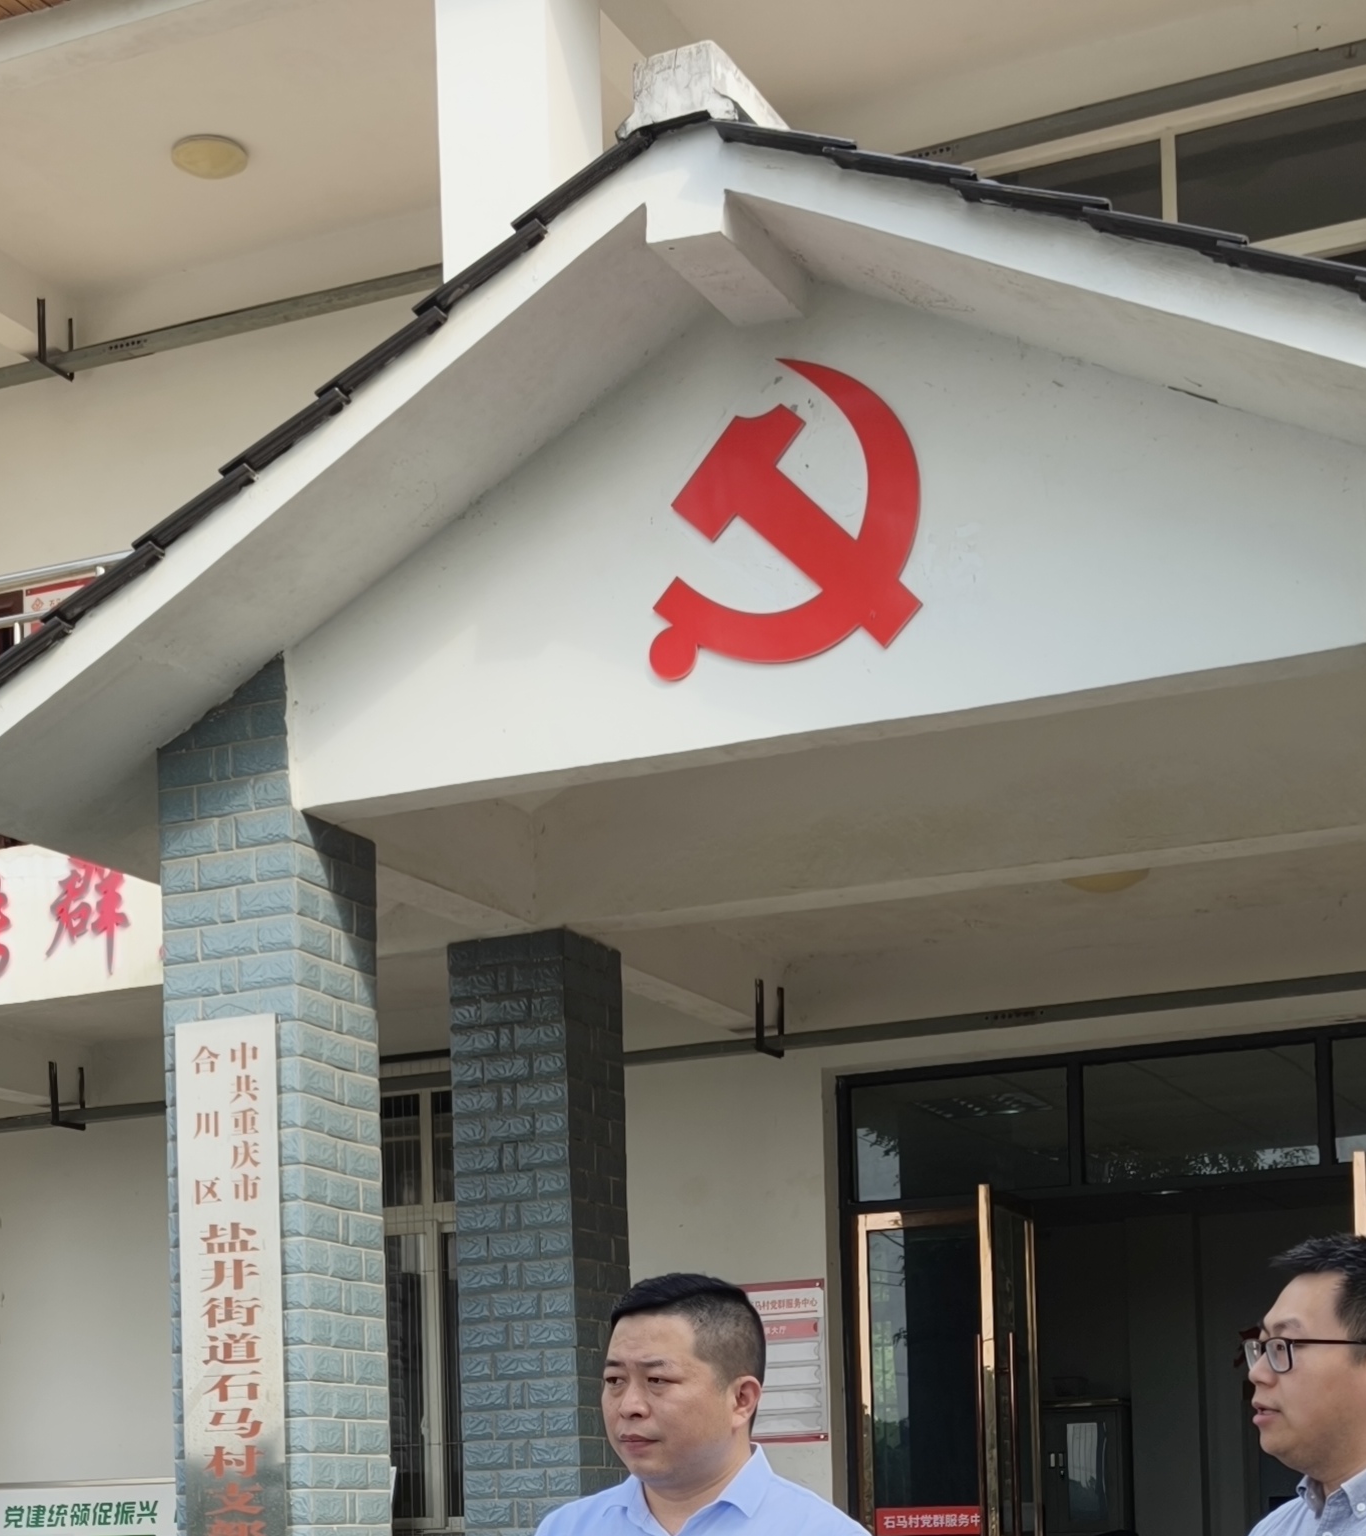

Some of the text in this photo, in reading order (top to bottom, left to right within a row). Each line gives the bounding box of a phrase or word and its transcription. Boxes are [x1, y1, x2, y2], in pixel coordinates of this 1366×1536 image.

[191, 1045, 223, 1206] 合川区
[230, 1041, 262, 1203] 中共重庆市
[753, 1297, 818, 1311] 马村党群服务中心
[3, 1500, 159, 1529] 党建统领促振兴
